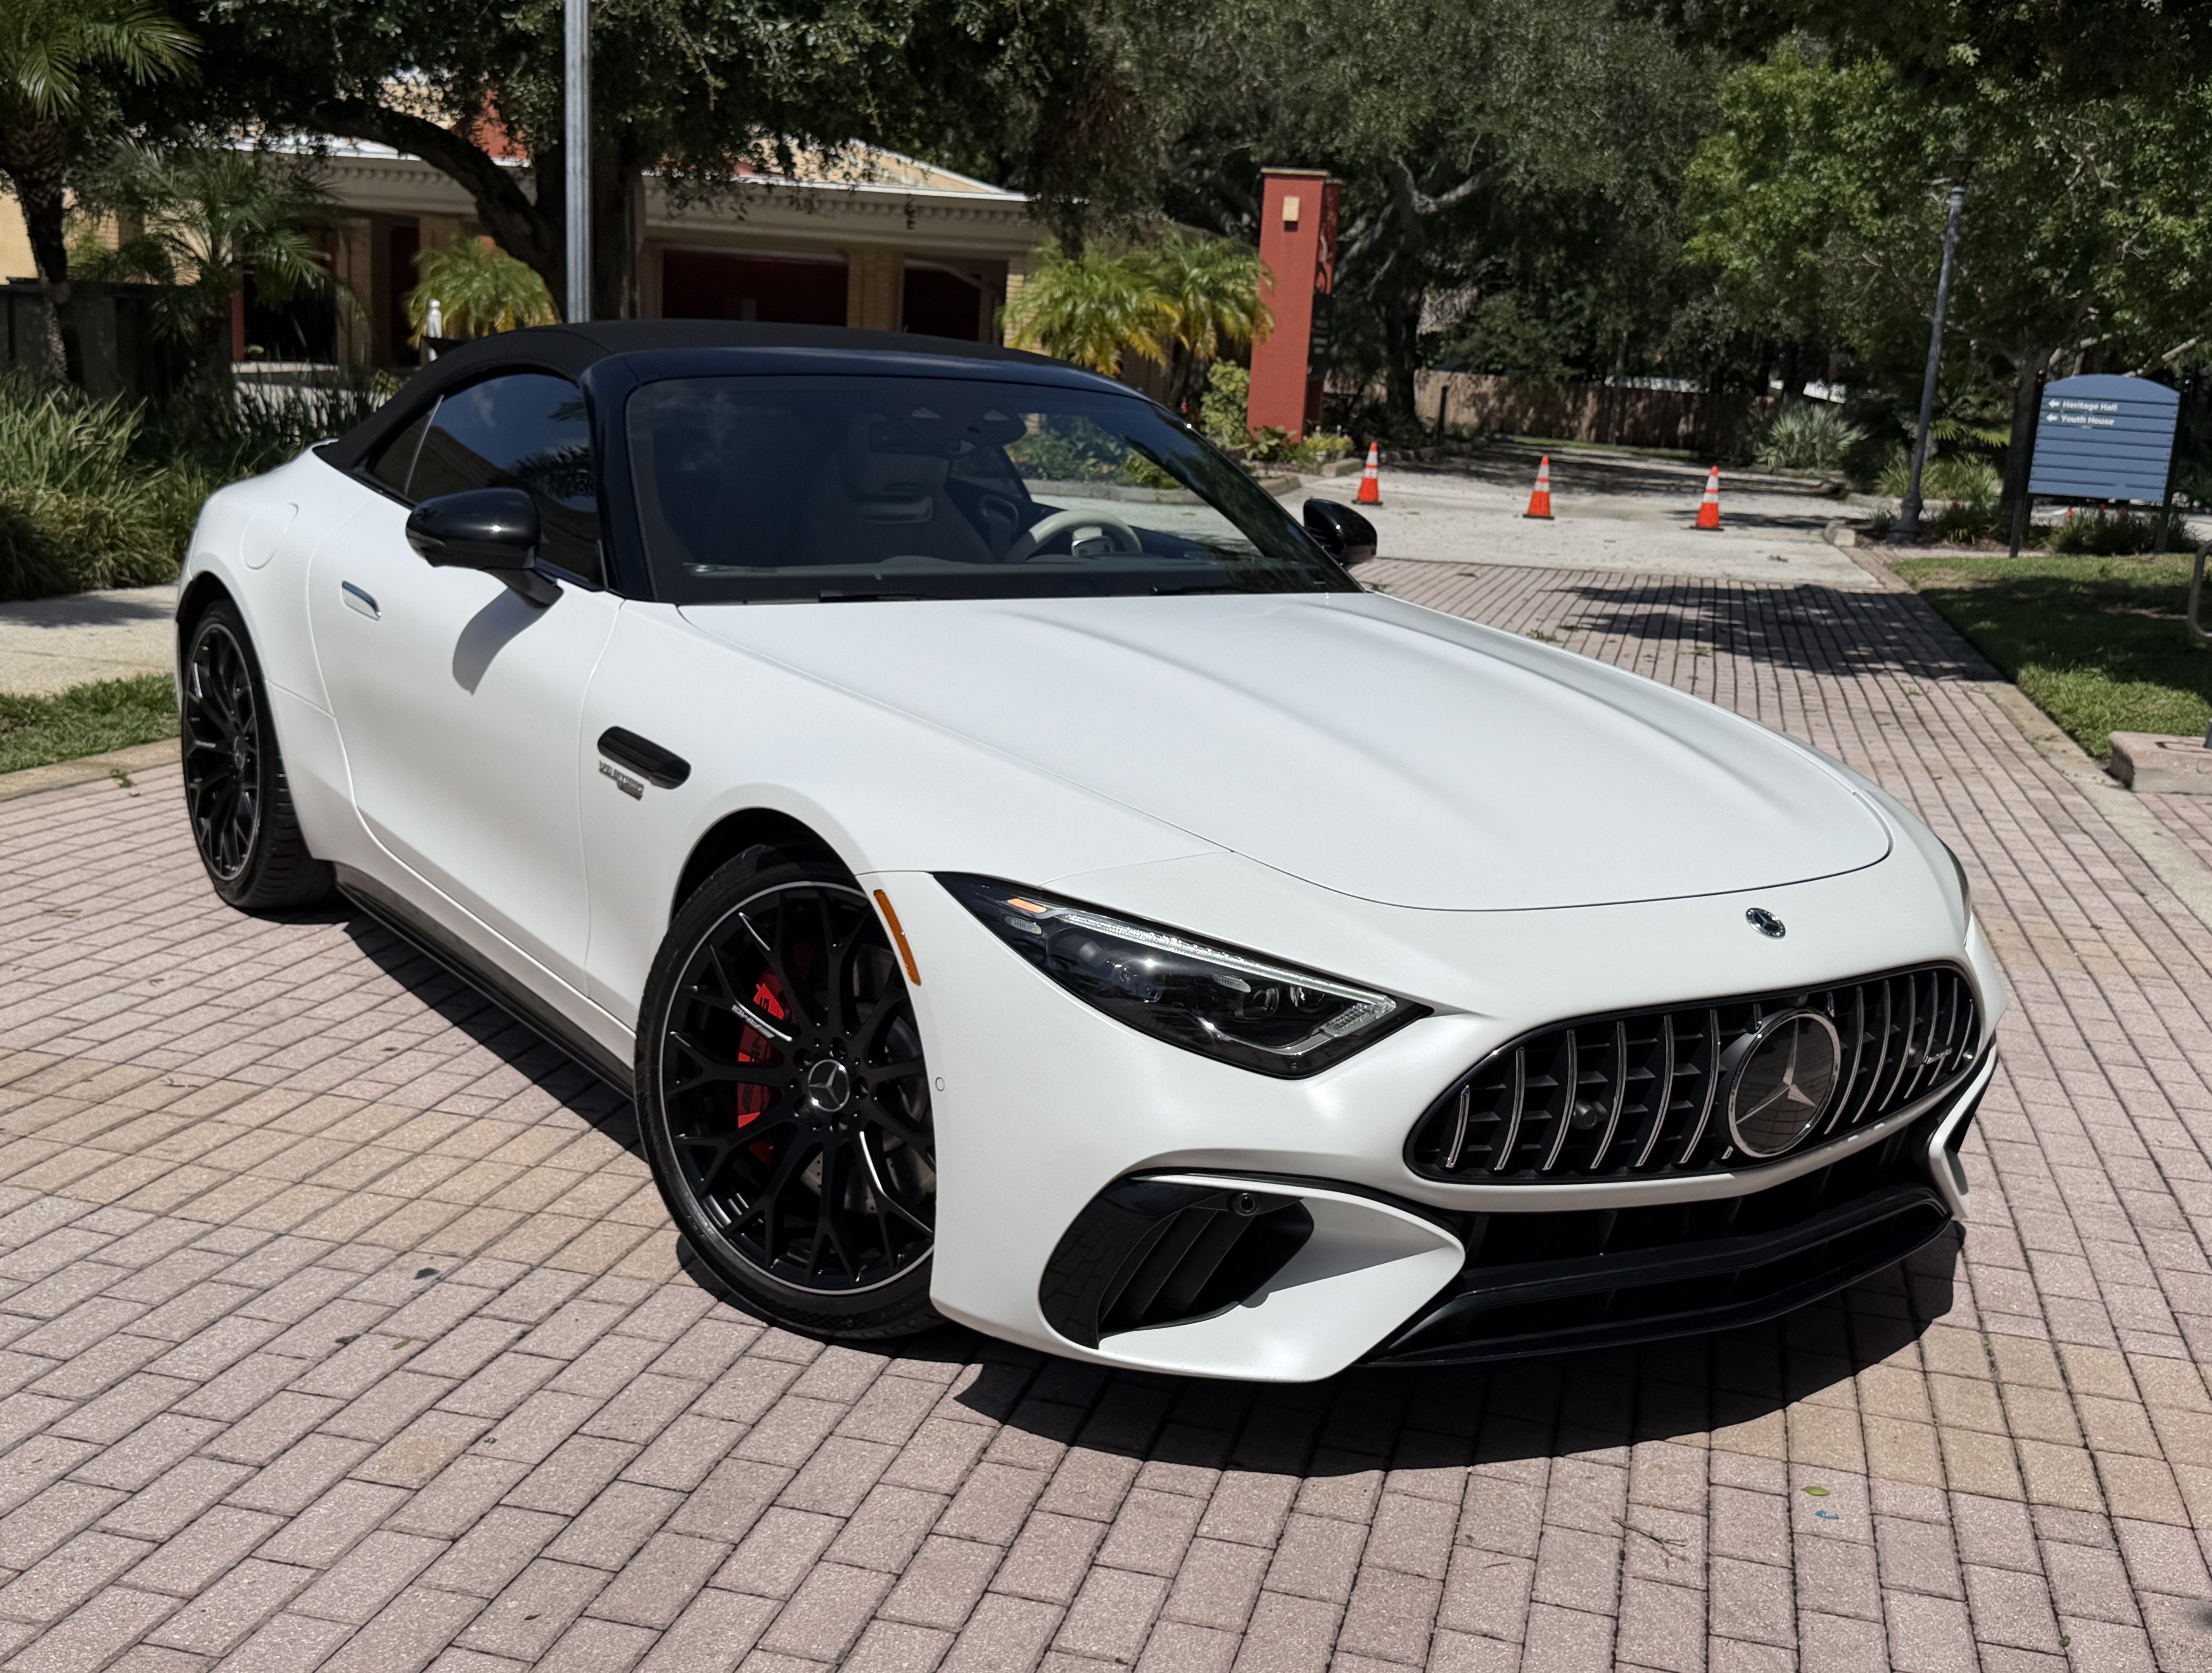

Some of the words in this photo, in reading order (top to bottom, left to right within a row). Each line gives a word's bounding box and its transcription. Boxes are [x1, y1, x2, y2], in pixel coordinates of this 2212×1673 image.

[2063, 400, 2098, 411] Heritage
[2100, 402, 2118, 412] Hall
[2061, 414, 2086, 423] Youth
[2087, 416, 2114, 425] House
